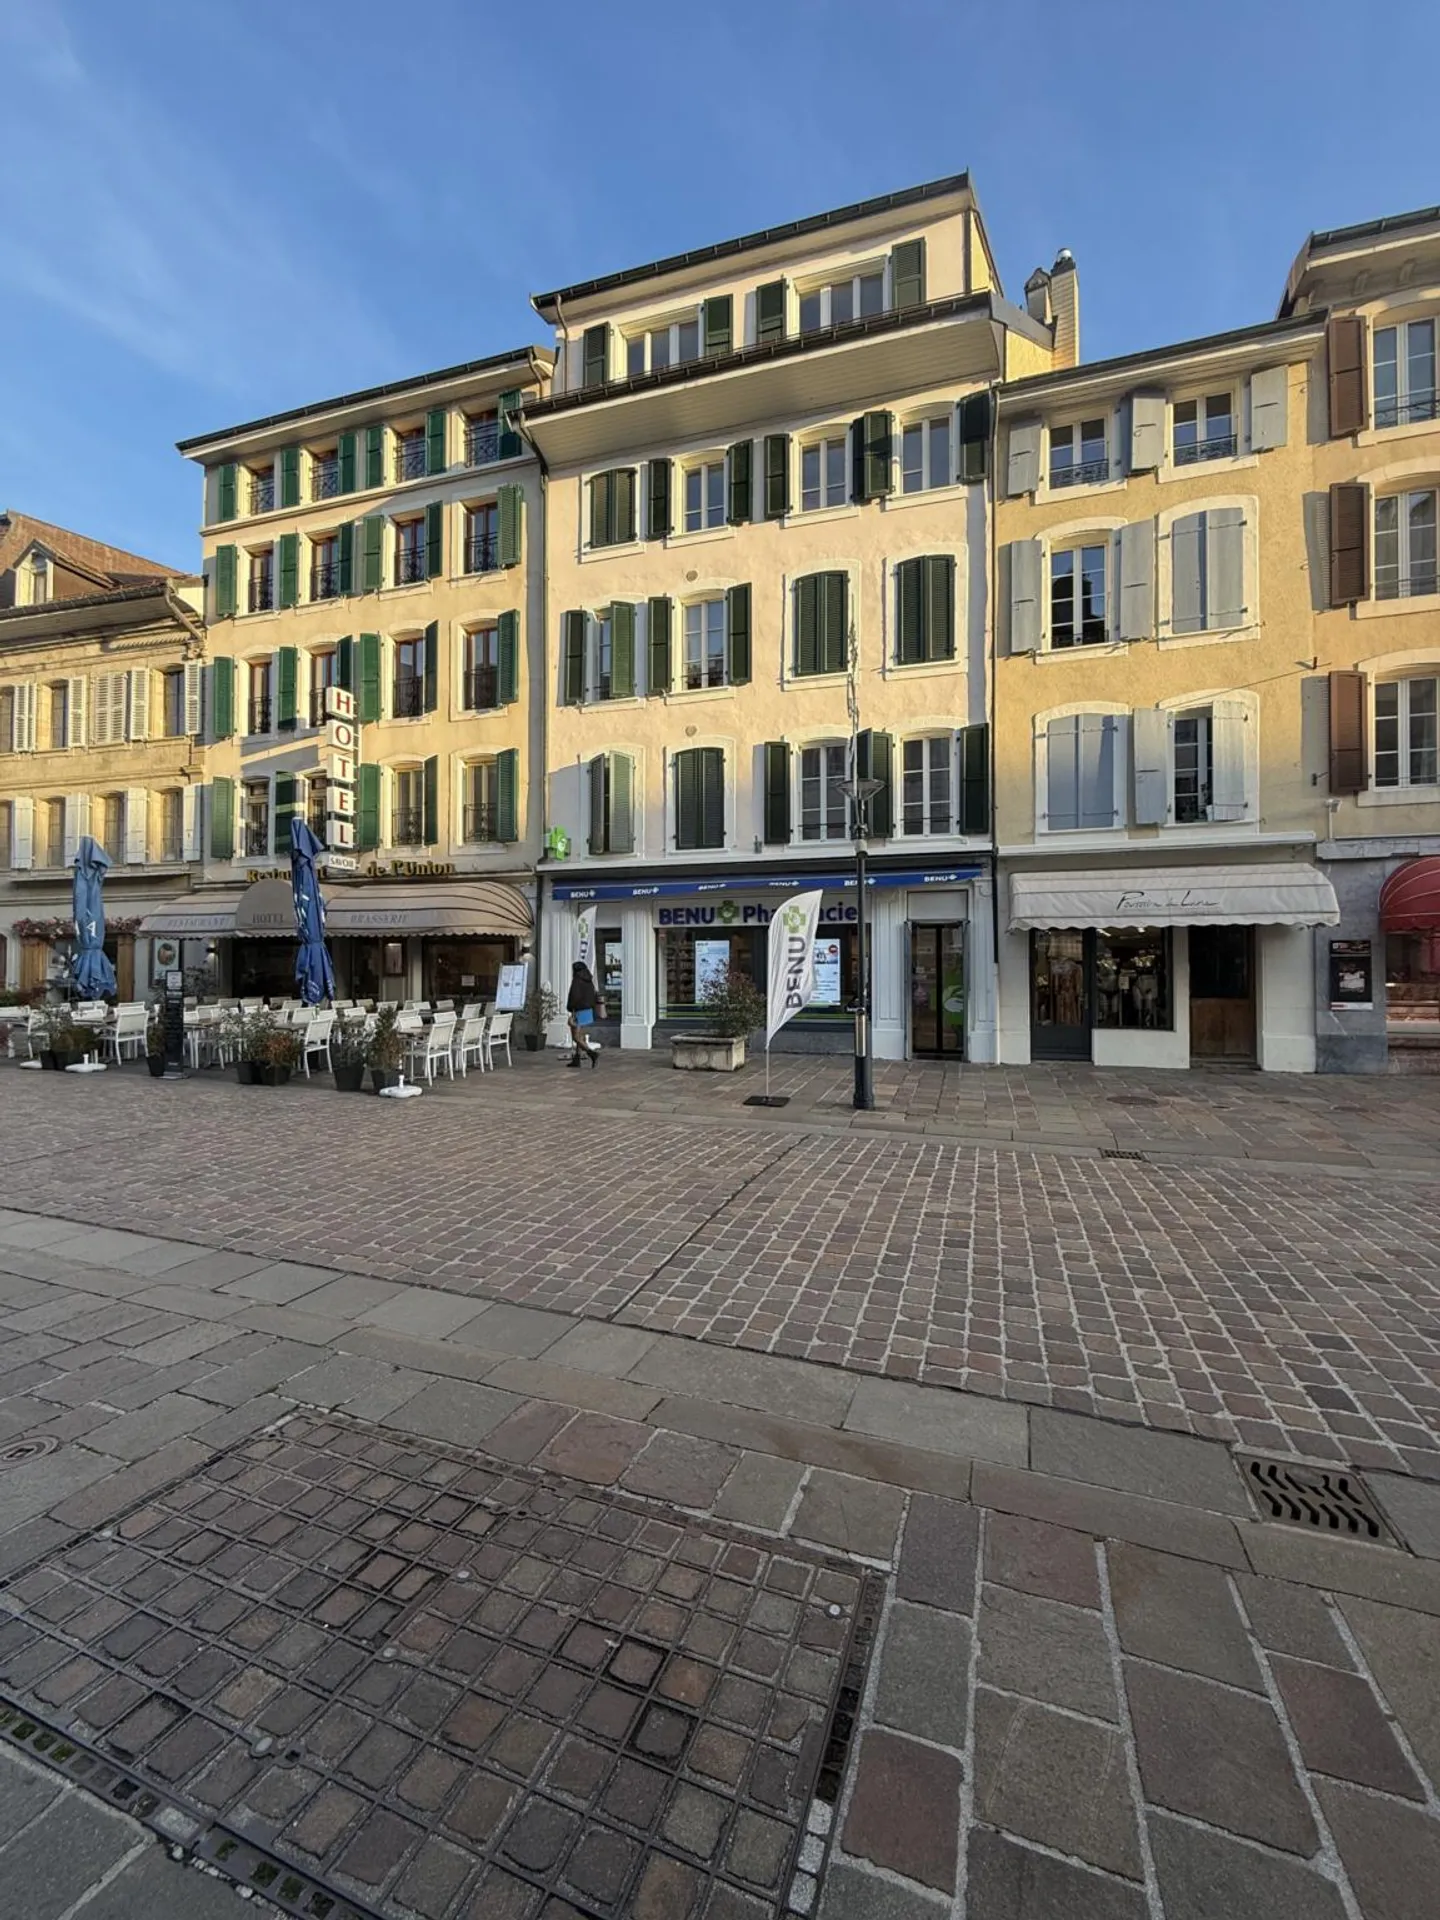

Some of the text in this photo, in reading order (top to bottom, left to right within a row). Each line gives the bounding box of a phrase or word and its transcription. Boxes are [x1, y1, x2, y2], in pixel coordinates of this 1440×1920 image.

[335, 691, 352, 844] HOTEL
[367, 861, 386, 877] de
[390, 860, 456, 876] l'Union
[570, 891, 589, 899] BENU
[633, 888, 652, 896] BENU
[659, 907, 715, 926] BENU
[786, 937, 806, 1009] BENU
